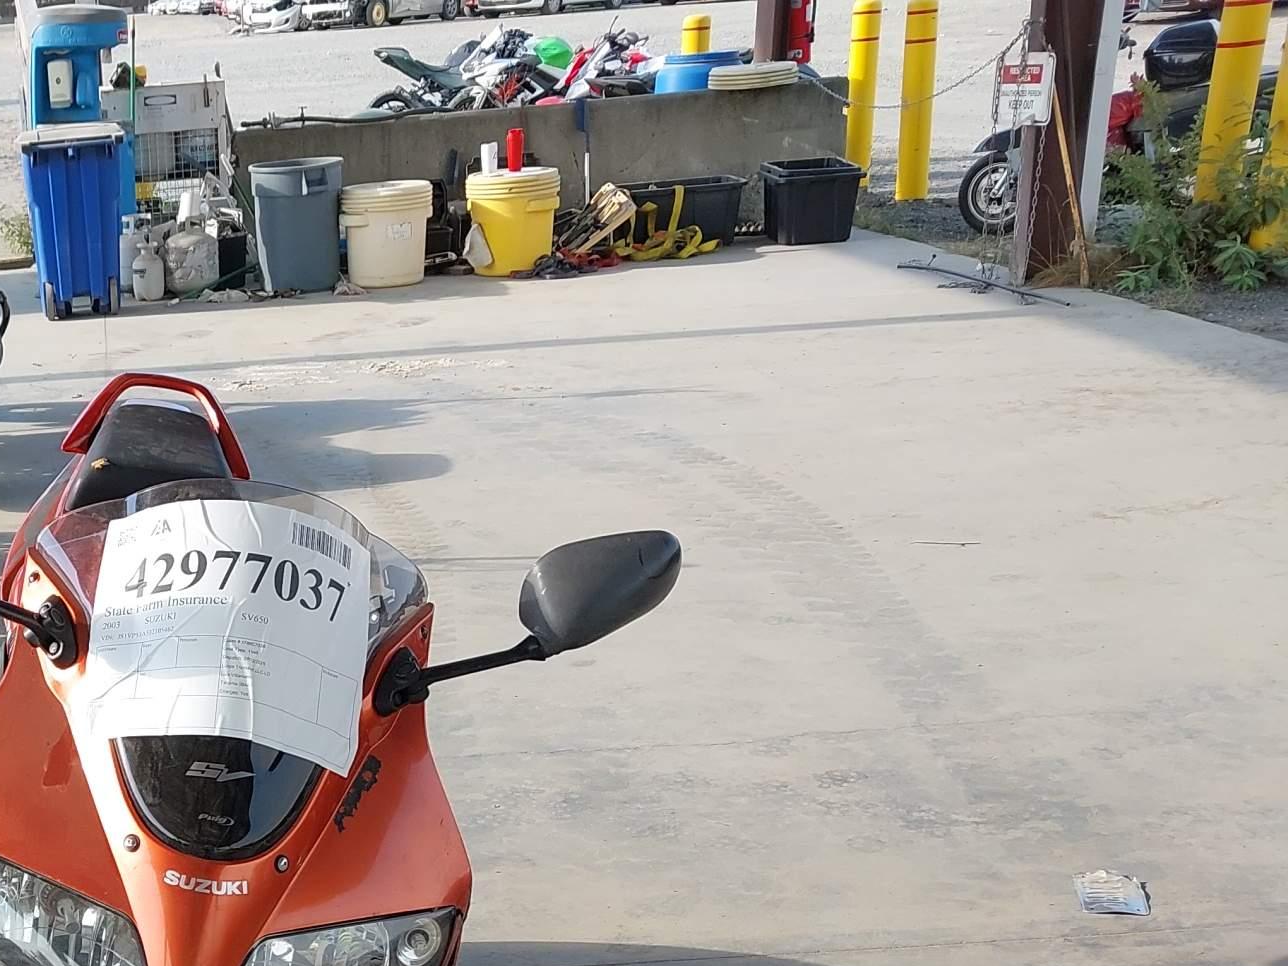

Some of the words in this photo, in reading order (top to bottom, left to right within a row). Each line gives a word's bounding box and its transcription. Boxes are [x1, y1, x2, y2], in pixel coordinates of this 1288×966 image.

[1010, 66, 1041, 75] RESCTED
[125, 550, 346, 622] 42977037
[105, 606, 133, 618] State
[168, 595, 228, 607] Insurance
[103, 620, 121, 631] 2003
[144, 612, 177, 625] SUZUKI
[241, 612, 269, 625] SV650
[185, 761, 257, 783] SV
[198, 813, 235, 827] Puig
[163, 869, 249, 896] SUZUKI
